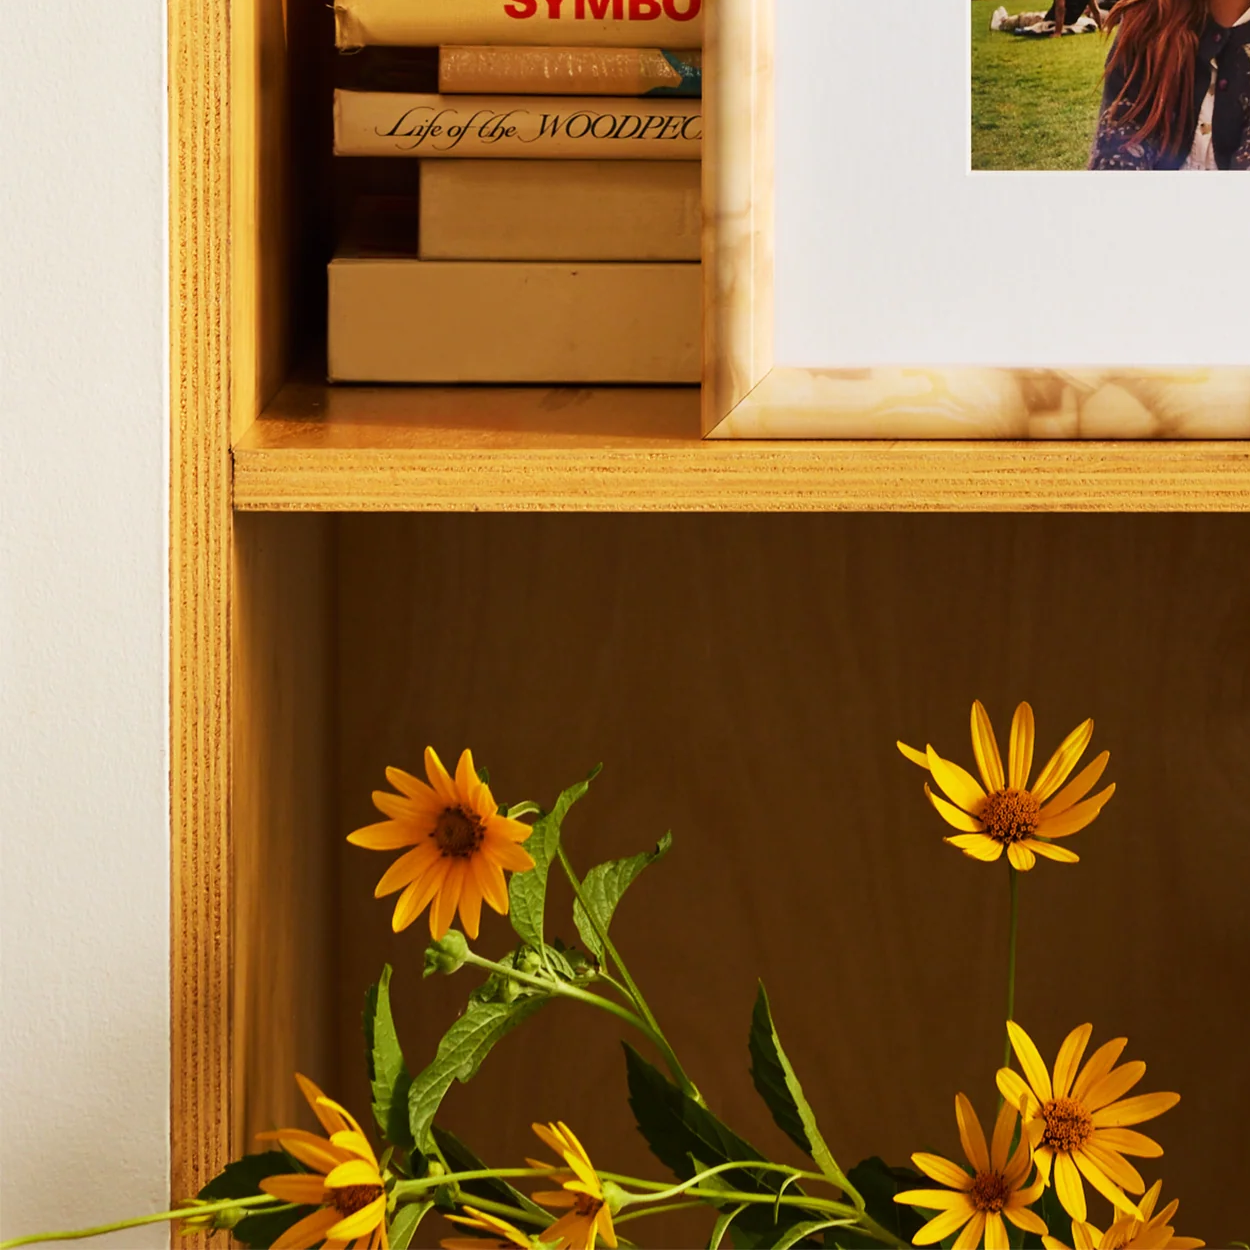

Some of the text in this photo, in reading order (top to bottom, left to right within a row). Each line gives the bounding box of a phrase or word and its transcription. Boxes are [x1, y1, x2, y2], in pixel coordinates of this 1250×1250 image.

[375, 106, 703, 151] Life of the WOODPEC
